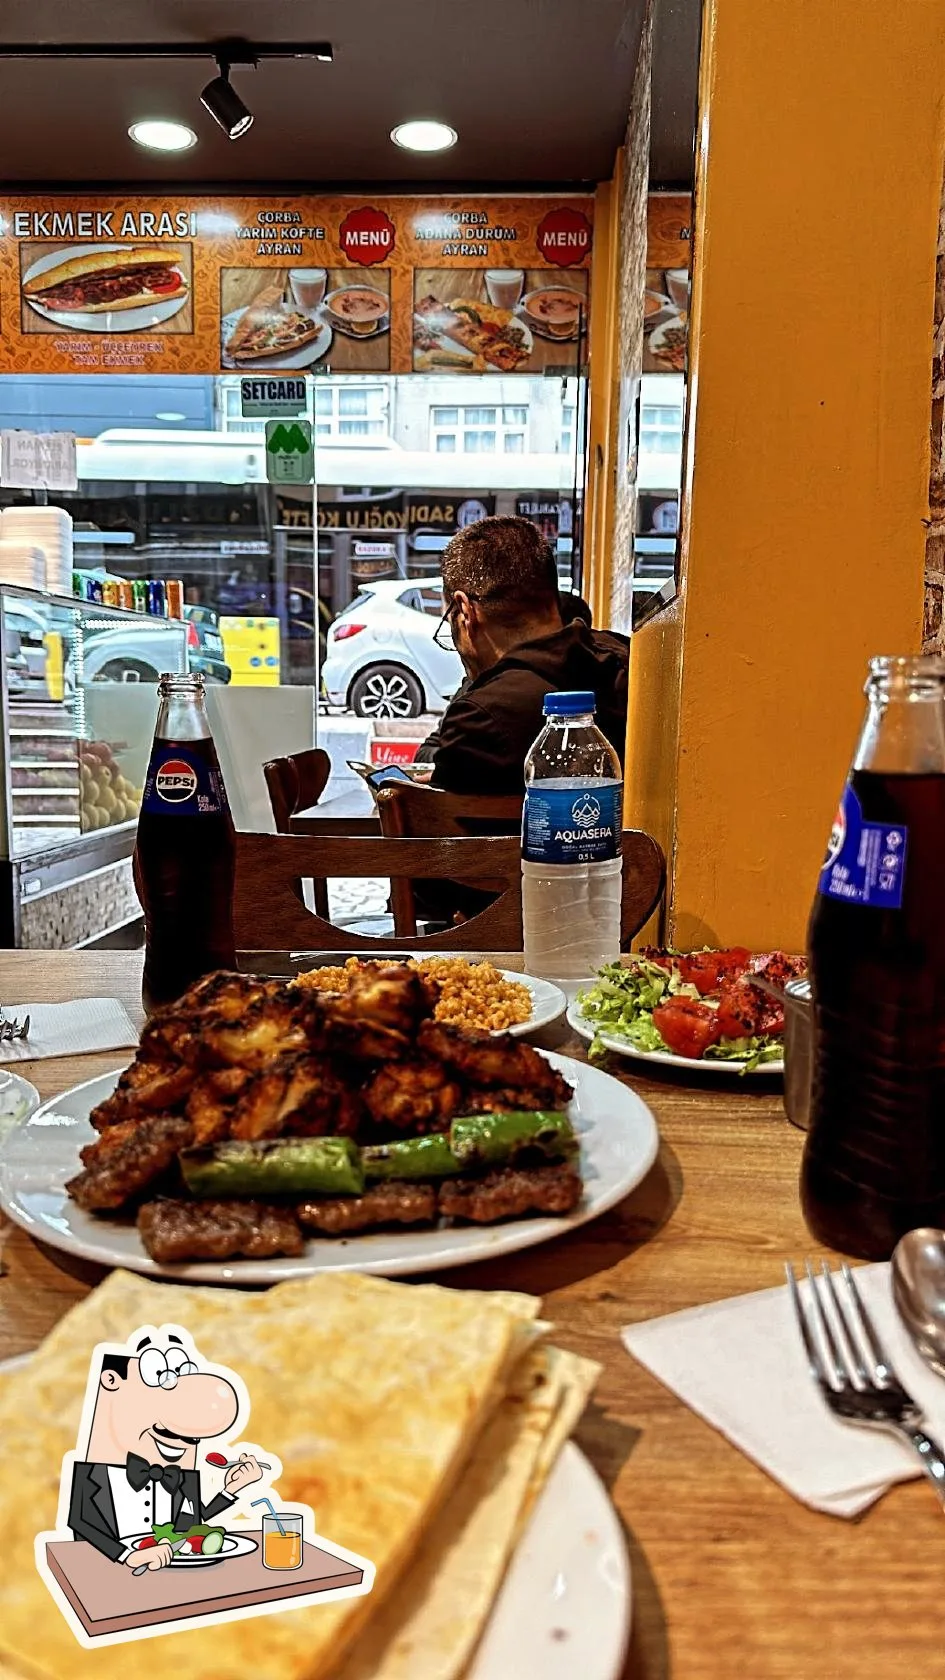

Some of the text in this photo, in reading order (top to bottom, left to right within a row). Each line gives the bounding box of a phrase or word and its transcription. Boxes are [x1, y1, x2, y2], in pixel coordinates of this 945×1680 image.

[13, 211, 115, 237] EKMEK
[119, 211, 199, 237] ARASI
[234, 227, 278, 240] YARIM
[345, 228, 391, 246] MENÜ
[415, 228, 463, 241] ADANA
[542, 229, 589, 247] MENÜ
[256, 243, 303, 256] AYRAN
[442, 244, 489, 257] AYRAN
[242, 381, 306, 400] SETCARD
[158, 776, 195, 787] PEPSI
[554, 827, 612, 843] AQUASERA
[578, 852, 589, 861] 0,5
